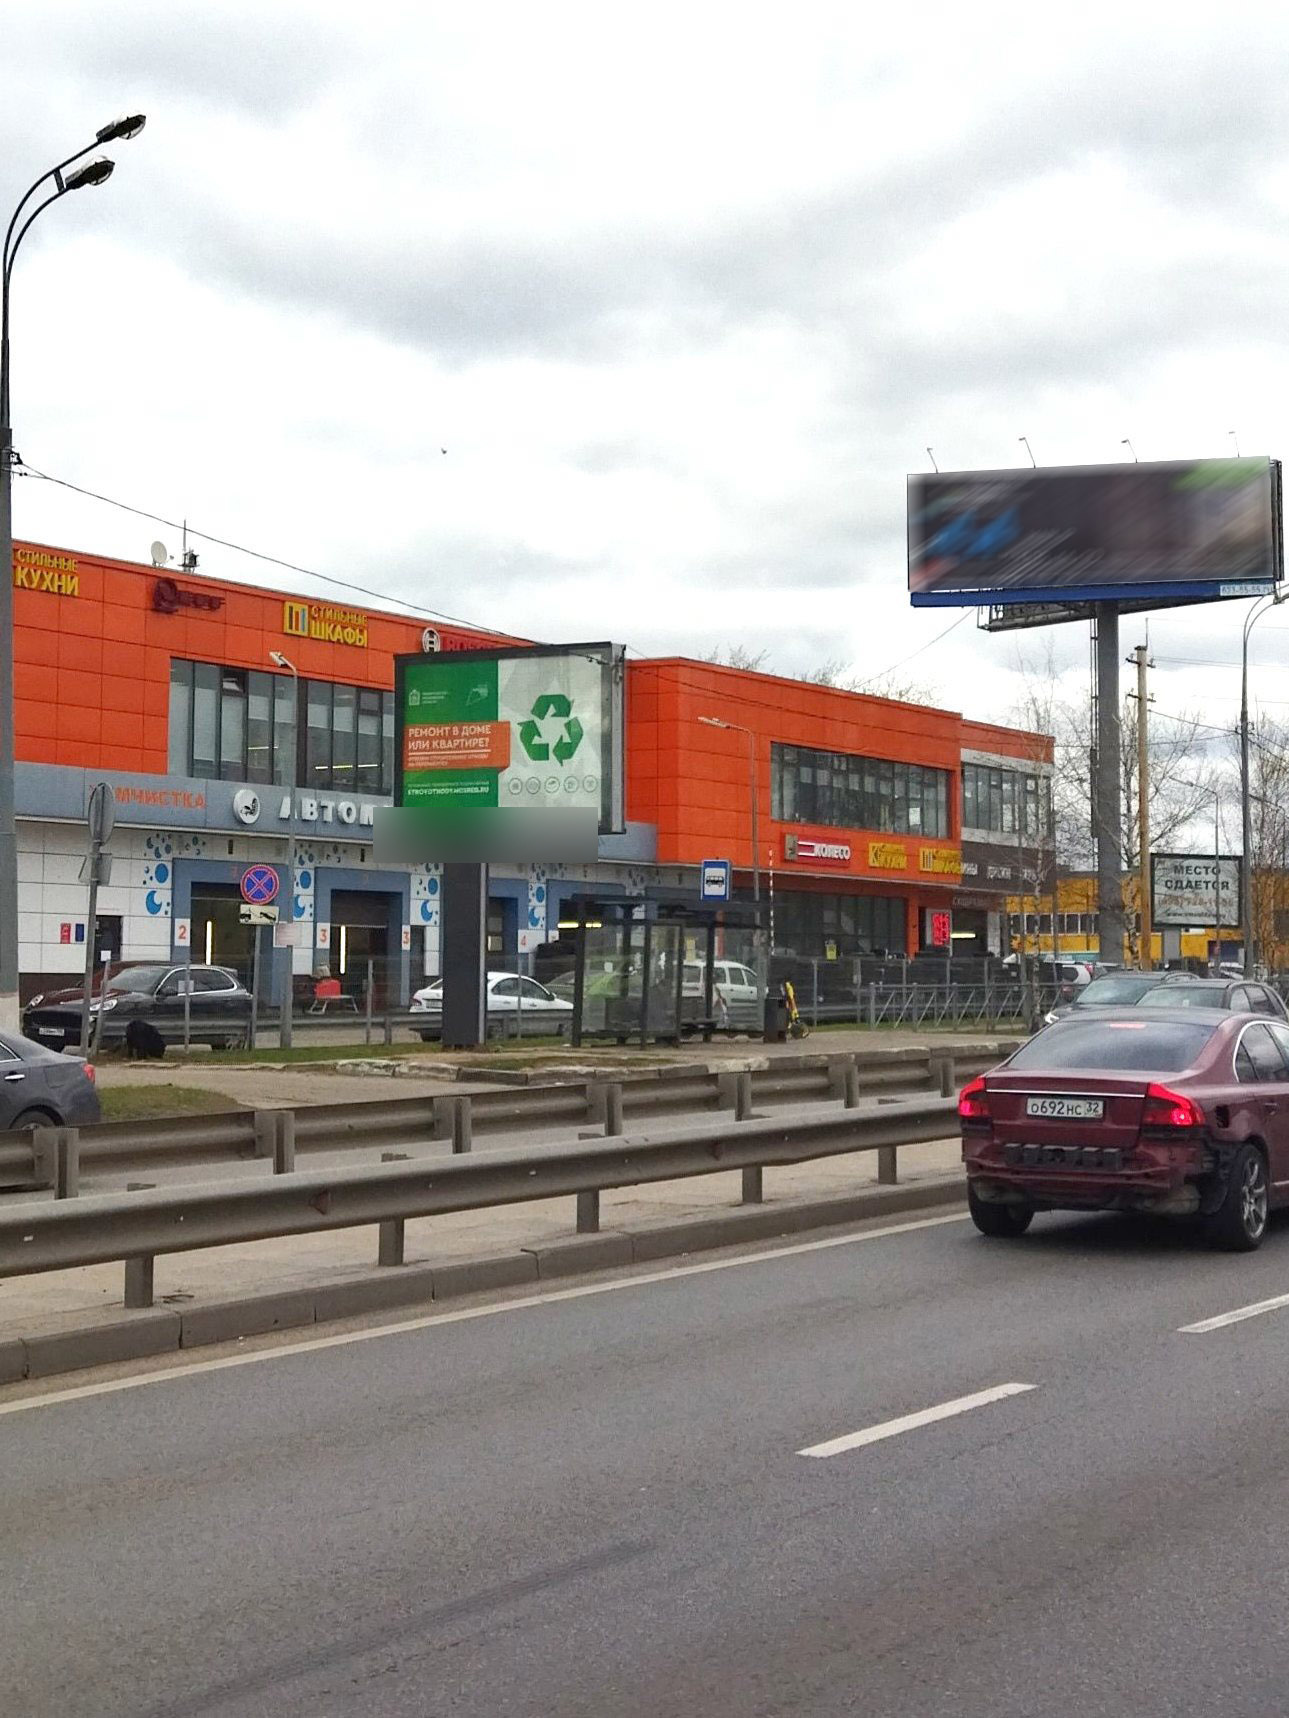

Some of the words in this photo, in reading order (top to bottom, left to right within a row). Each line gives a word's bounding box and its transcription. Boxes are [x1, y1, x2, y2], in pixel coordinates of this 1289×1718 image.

[17, 548, 78, 573] СТИЛЬНЫЕ
[15, 565, 79, 596] КУХНИ
[311, 605, 367, 626] СТИЛЬНЫЕ
[311, 620, 367, 648] ШКАФЫ
[408, 727, 450, 737] РЕМОНТ
[453, 726, 459, 736] В
[462, 725, 491, 736] ДОМЕ
[408, 740, 429, 750] ИЛИ
[432, 737, 489, 749] КВАРТИРЕ?
[1165, 879, 1230, 891] СДАЕТСЯ
[178, 925, 187, 939] 2
[320, 929, 327, 943] 3
[403, 931, 409, 945] 3
[1086, 1102, 1099, 1113] 32
